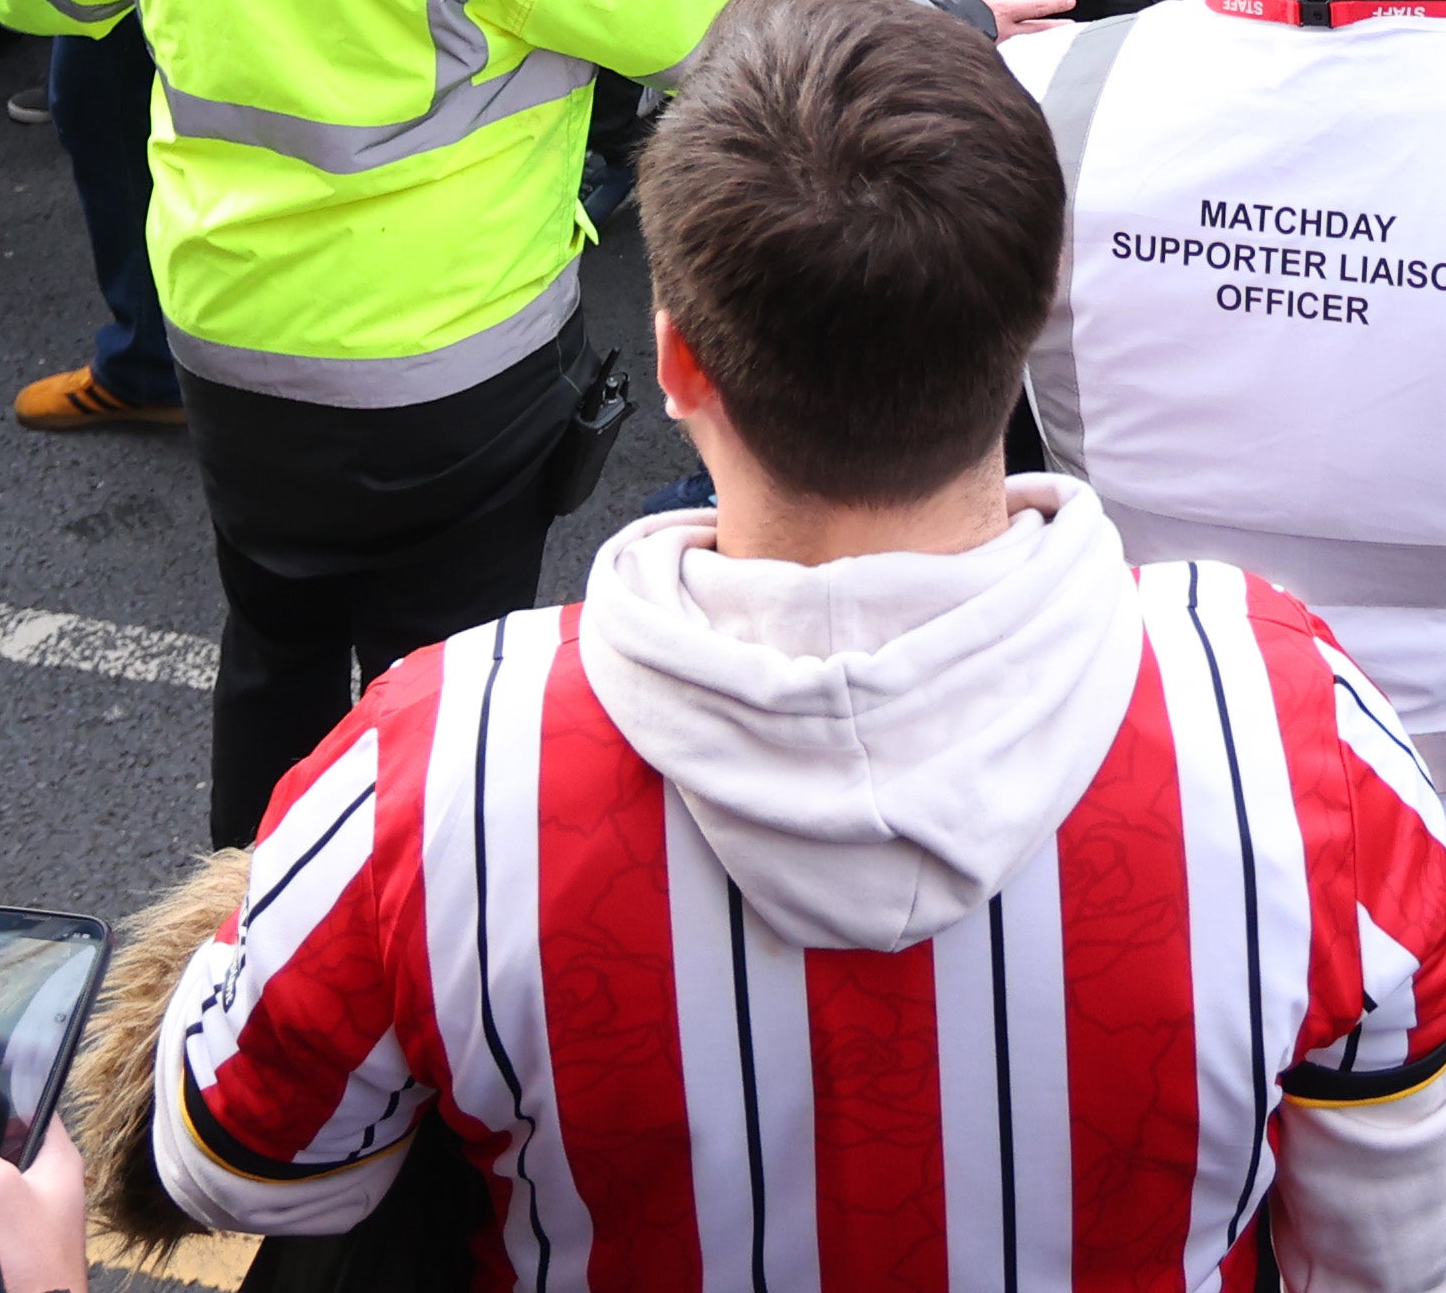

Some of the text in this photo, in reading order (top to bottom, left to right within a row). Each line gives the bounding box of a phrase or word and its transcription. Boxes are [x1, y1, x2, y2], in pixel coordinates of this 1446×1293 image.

[1199, 199, 1397, 243] MATCHDAY
[1110, 231, 1328, 280] SUPPORTER
[1215, 283, 1371, 326] OFFICER
